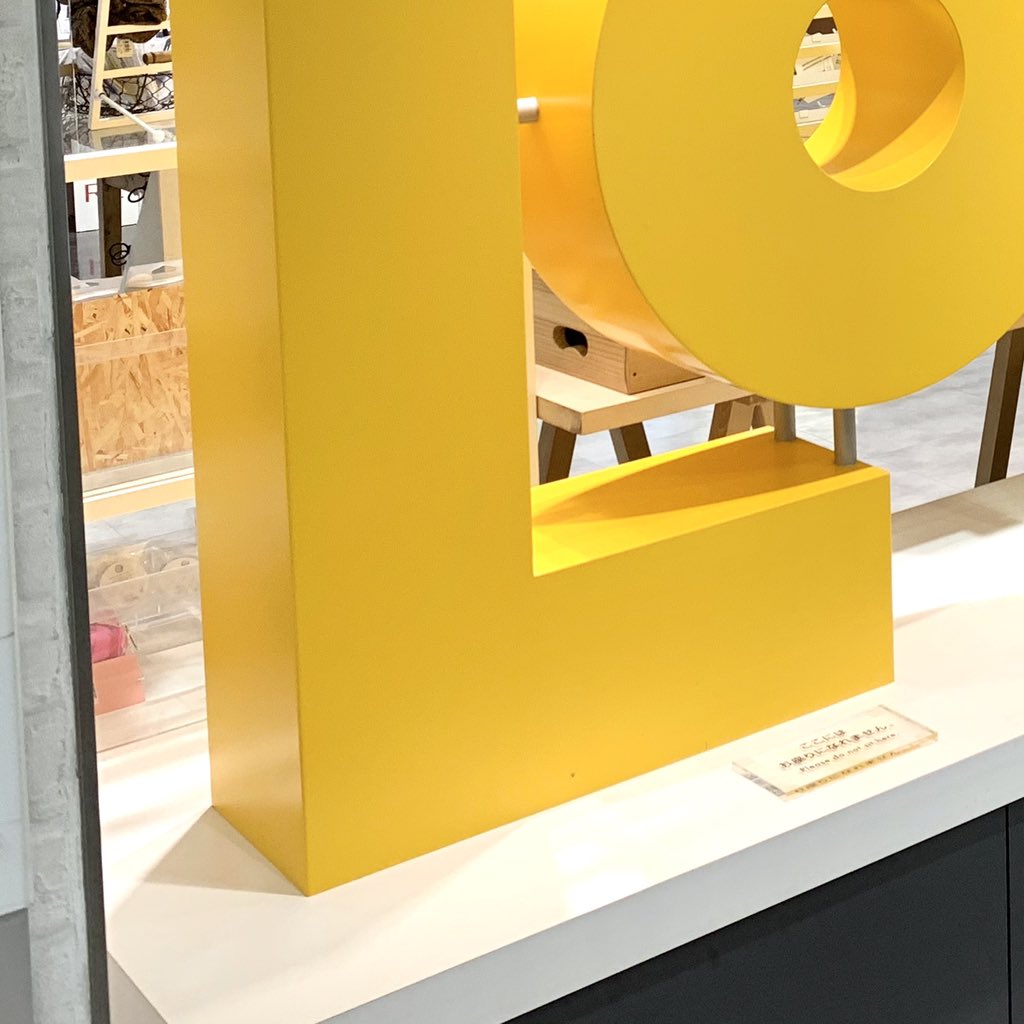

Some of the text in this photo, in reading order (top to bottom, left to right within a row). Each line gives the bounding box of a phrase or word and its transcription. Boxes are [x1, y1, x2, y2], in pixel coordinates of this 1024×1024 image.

[799, 759, 830, 773] Please
[833, 752, 845, 761] do
[847, 745, 862, 754] not
[875, 733, 896, 743] here
[800, 729, 846, 750] ここには
